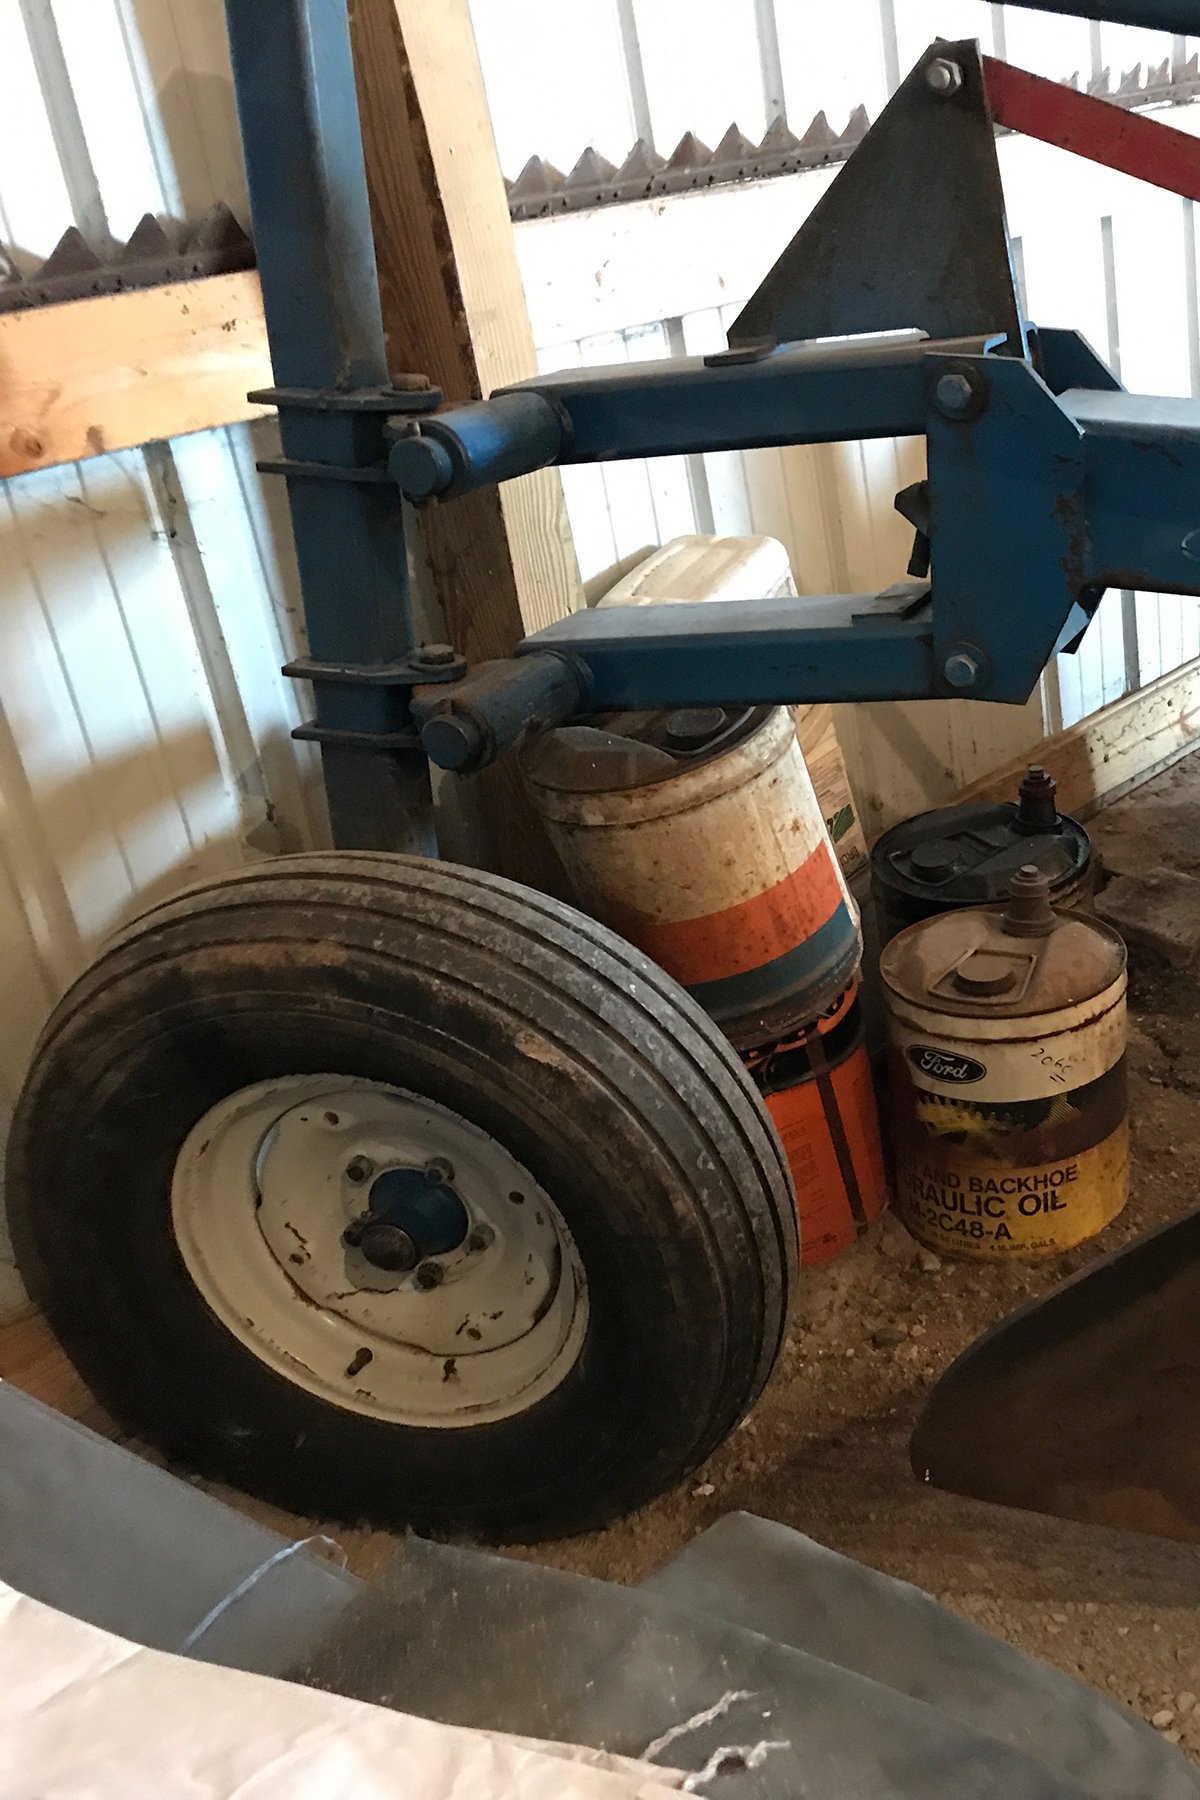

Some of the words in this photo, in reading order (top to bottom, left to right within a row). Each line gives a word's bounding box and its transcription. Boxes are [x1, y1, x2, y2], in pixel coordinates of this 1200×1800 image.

[920, 1050, 971, 1080] Ford
[923, 1165, 961, 1189] AND
[969, 1164, 1079, 1194] BACKHOE
[1017, 1190, 1067, 1217] OIL
